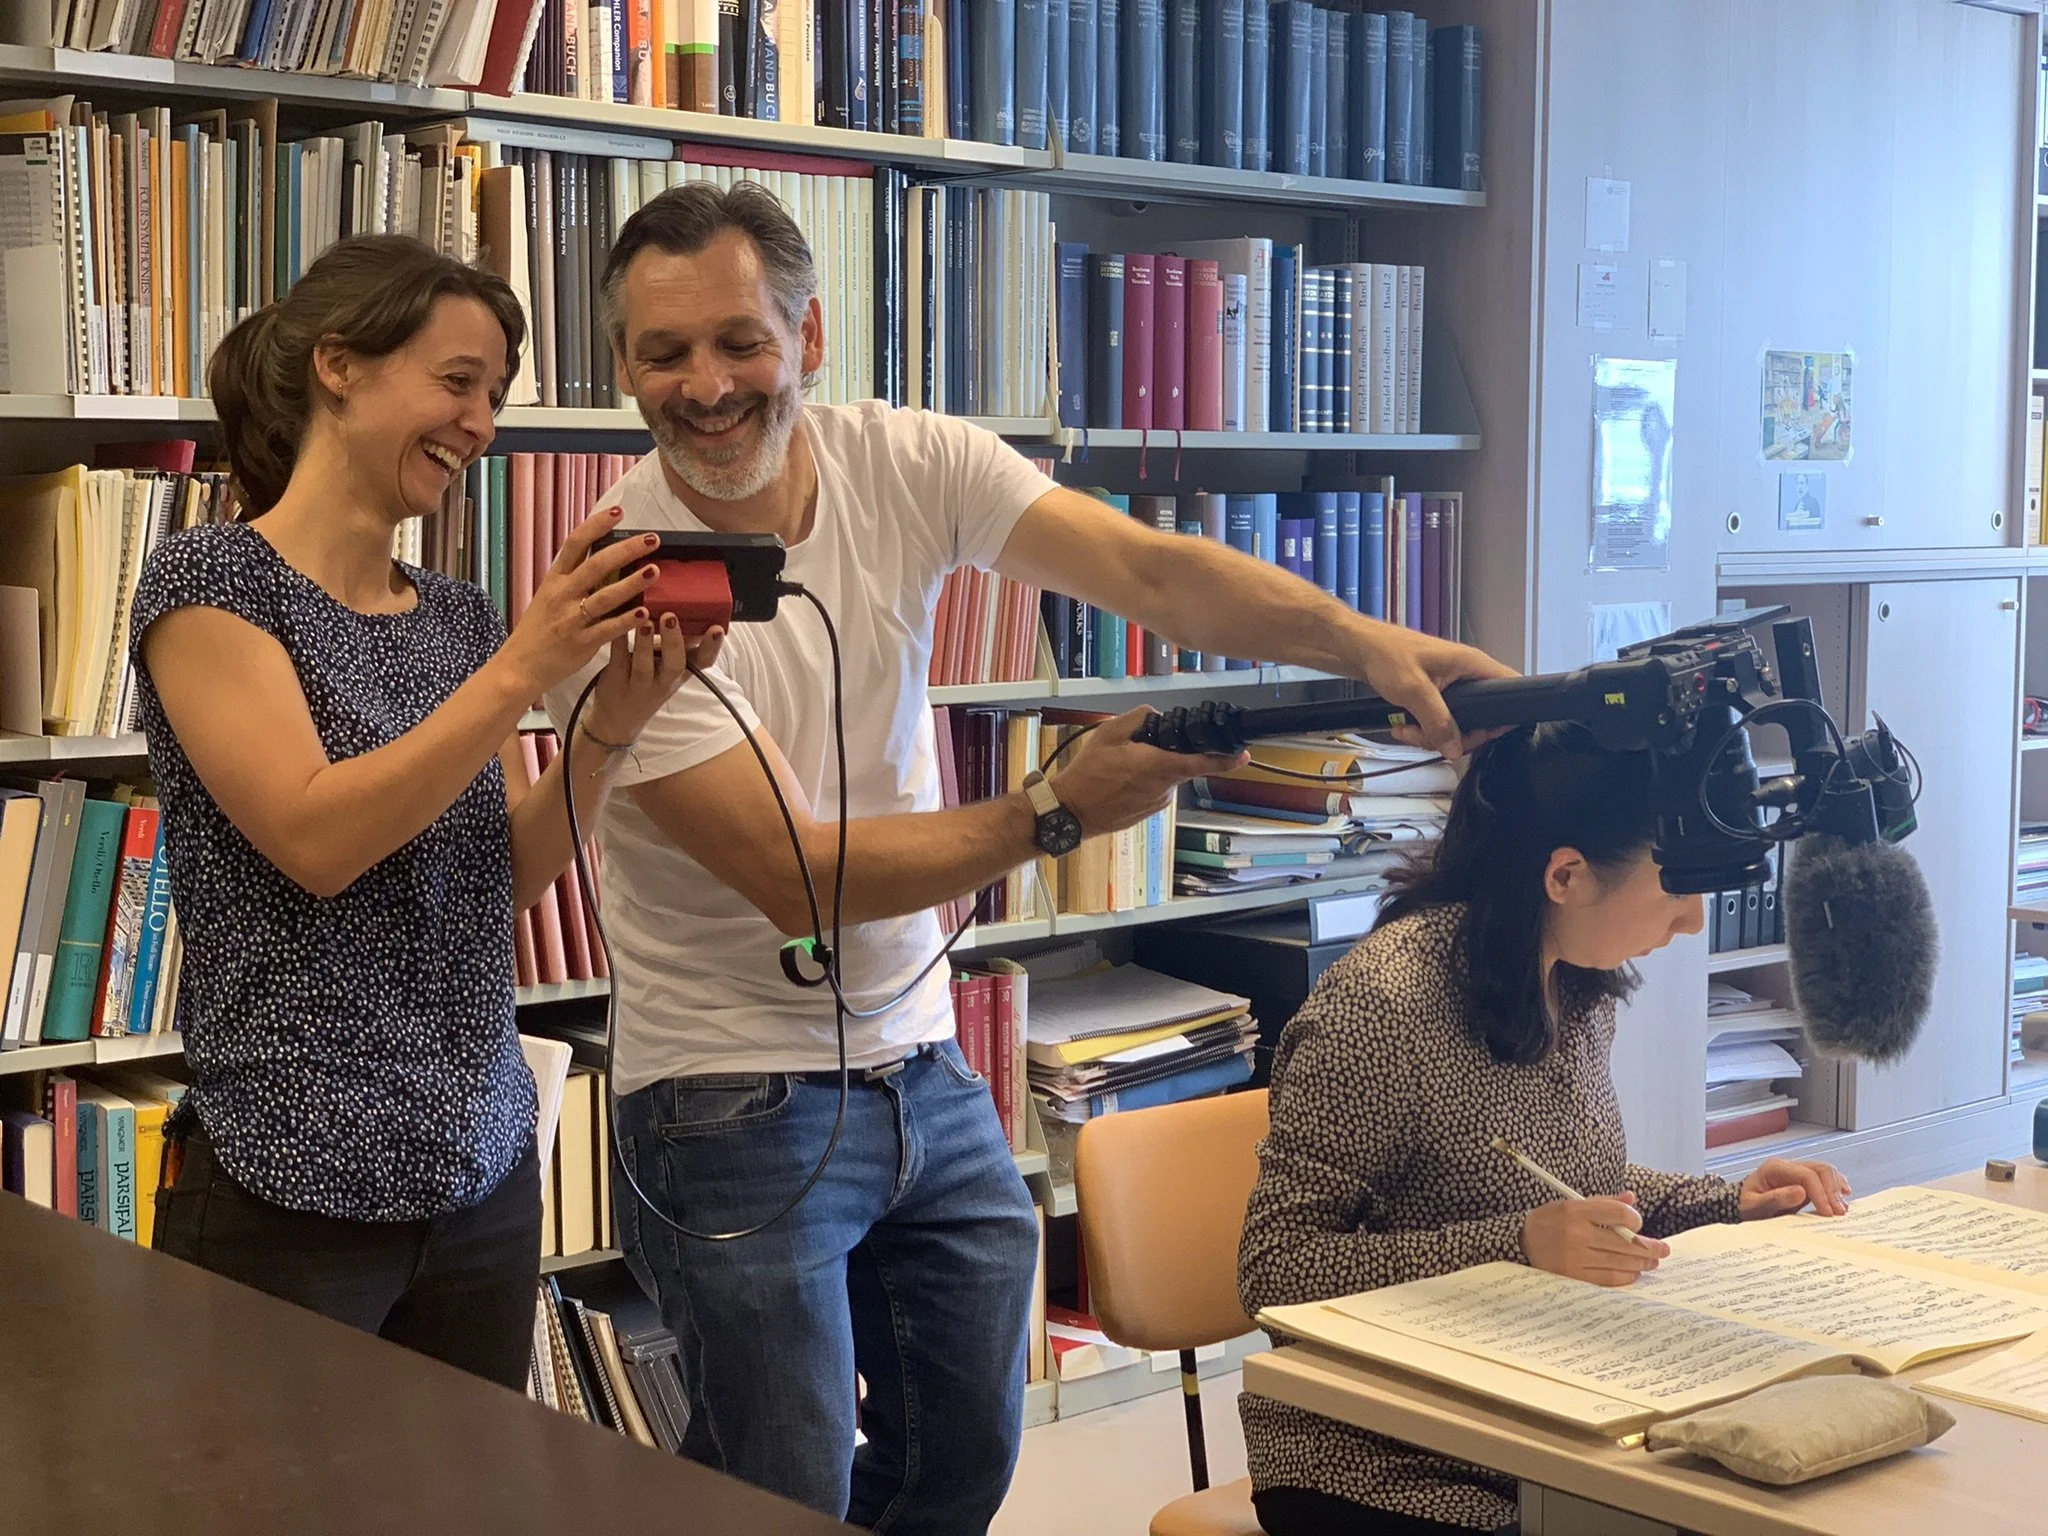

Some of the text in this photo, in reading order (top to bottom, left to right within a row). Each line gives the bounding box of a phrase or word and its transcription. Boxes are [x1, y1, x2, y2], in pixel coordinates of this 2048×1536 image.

[566, 0, 577, 76] ANDBUCH
[613, 0, 622, 71] HLER Companion
[140, 186, 150, 218] FOUR
[140, 219, 151, 294] SYMPHONIES
[1359, 280, 1367, 308] Band
[1413, 284, 1421, 311] Band
[1359, 325, 1367, 422] Händel-Handbuch
[1383, 326, 1391, 422] Händel-Handbuch
[1399, 327, 1408, 422] Händel-Handbuch
[1411, 326, 1420, 421] Händel-Handbuch
[91, 831, 111, 894] Verdi/Otello
[137, 819, 148, 839] Verdi
[71, 952, 94, 981] R
[78, 1110, 95, 1224] WAGNER PARSI
[114, 1115, 132, 1236] WAGNER PARSIFAL
